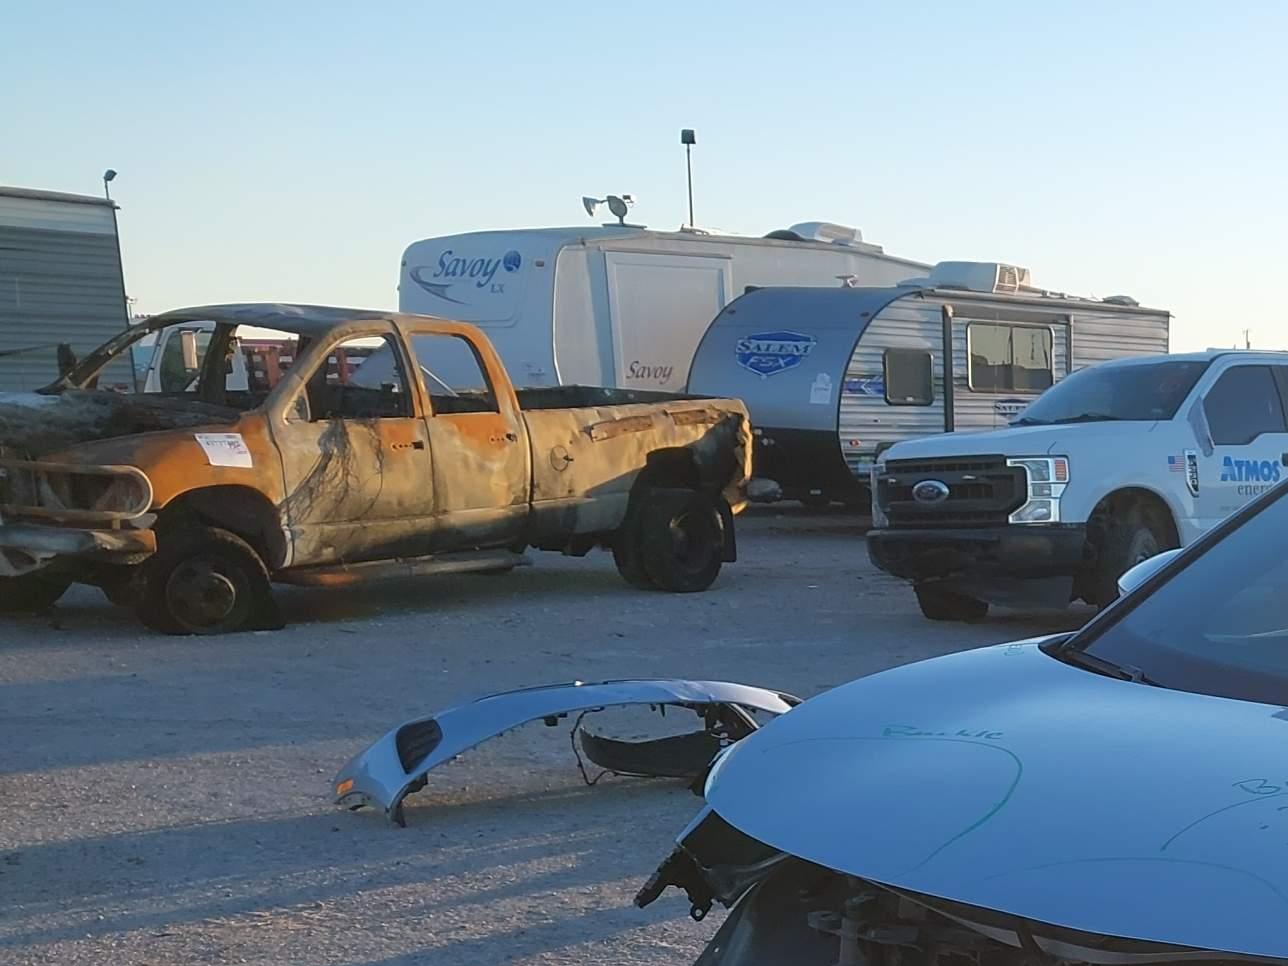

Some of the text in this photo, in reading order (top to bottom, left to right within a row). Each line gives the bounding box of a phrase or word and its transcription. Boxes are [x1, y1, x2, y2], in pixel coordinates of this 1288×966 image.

[433, 250, 501, 288] Savoy
[738, 340, 813, 355] SALEM
[626, 361, 673, 385] Savoy
[1220, 456, 1281, 481] ATMOS
[1237, 484, 1271, 497] ener
